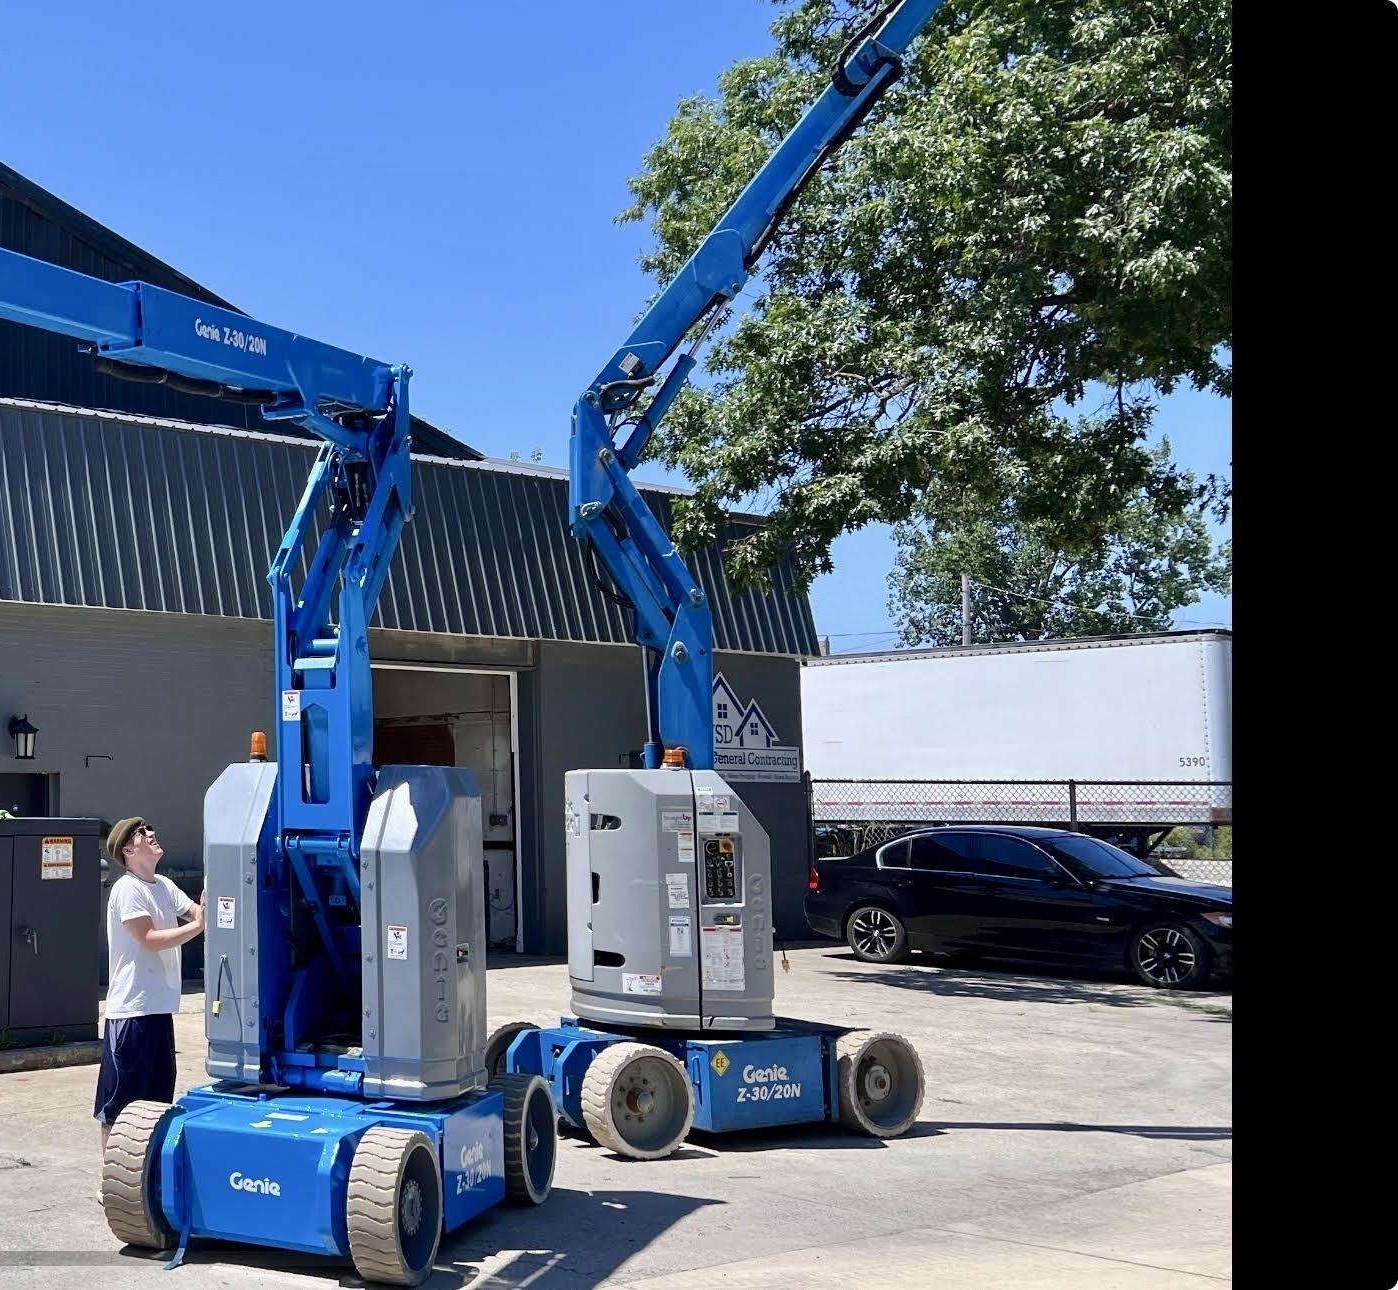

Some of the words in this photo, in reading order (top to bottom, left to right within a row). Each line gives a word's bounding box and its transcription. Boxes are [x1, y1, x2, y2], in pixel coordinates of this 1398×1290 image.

[195, 318, 220, 342] Genie
[223, 327, 266, 356] Z-30/20N
[713, 724, 733, 744] SD
[748, 752, 798, 770] Contracting
[1179, 756, 1206, 767] 5390
[428, 897, 449, 1023] Genie
[715, 1058, 725, 1068] EE
[743, 1064, 788, 1084] Genie
[737, 1083, 801, 1102] Z-30/20N
[461, 1141, 483, 1168] Genie
[229, 1171, 281, 1197] Genie
